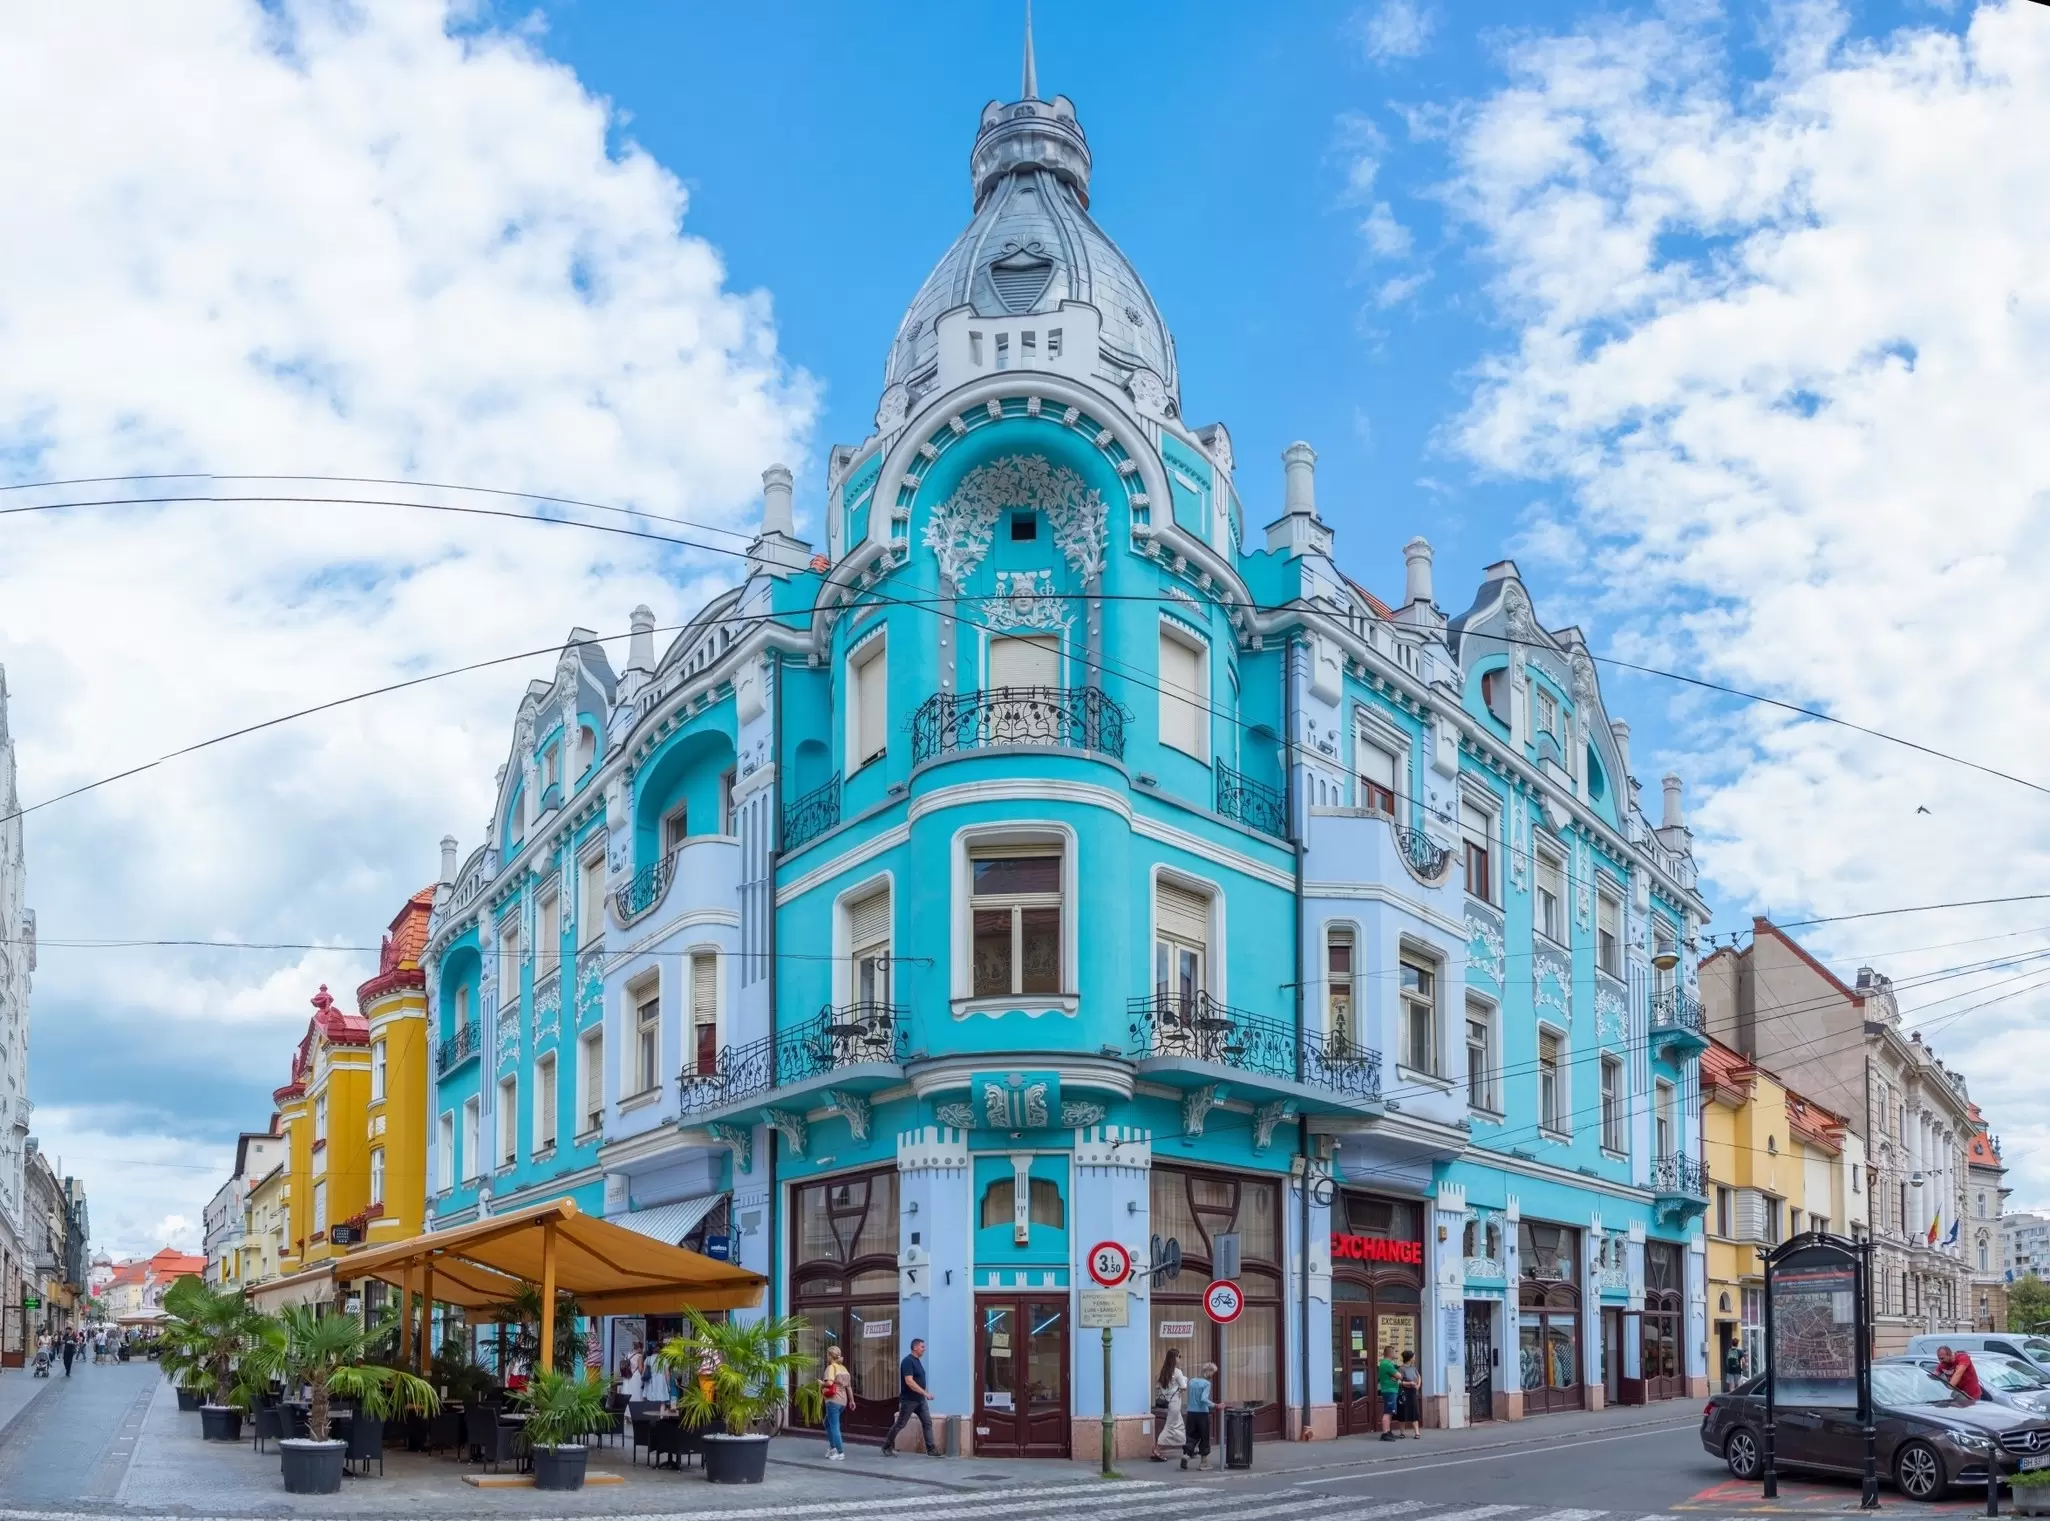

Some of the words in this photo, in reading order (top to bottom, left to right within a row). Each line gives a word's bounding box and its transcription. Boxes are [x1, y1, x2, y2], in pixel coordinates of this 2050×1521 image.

[1331, 1232, 1422, 1264] EXCHANGE
[1381, 1317, 1412, 1326] EXCHANGE
[865, 1323, 891, 1335] FRIZERIE
[1162, 1324, 1192, 1335] FRIZERIE
[2024, 1458, 2033, 1468] BH
